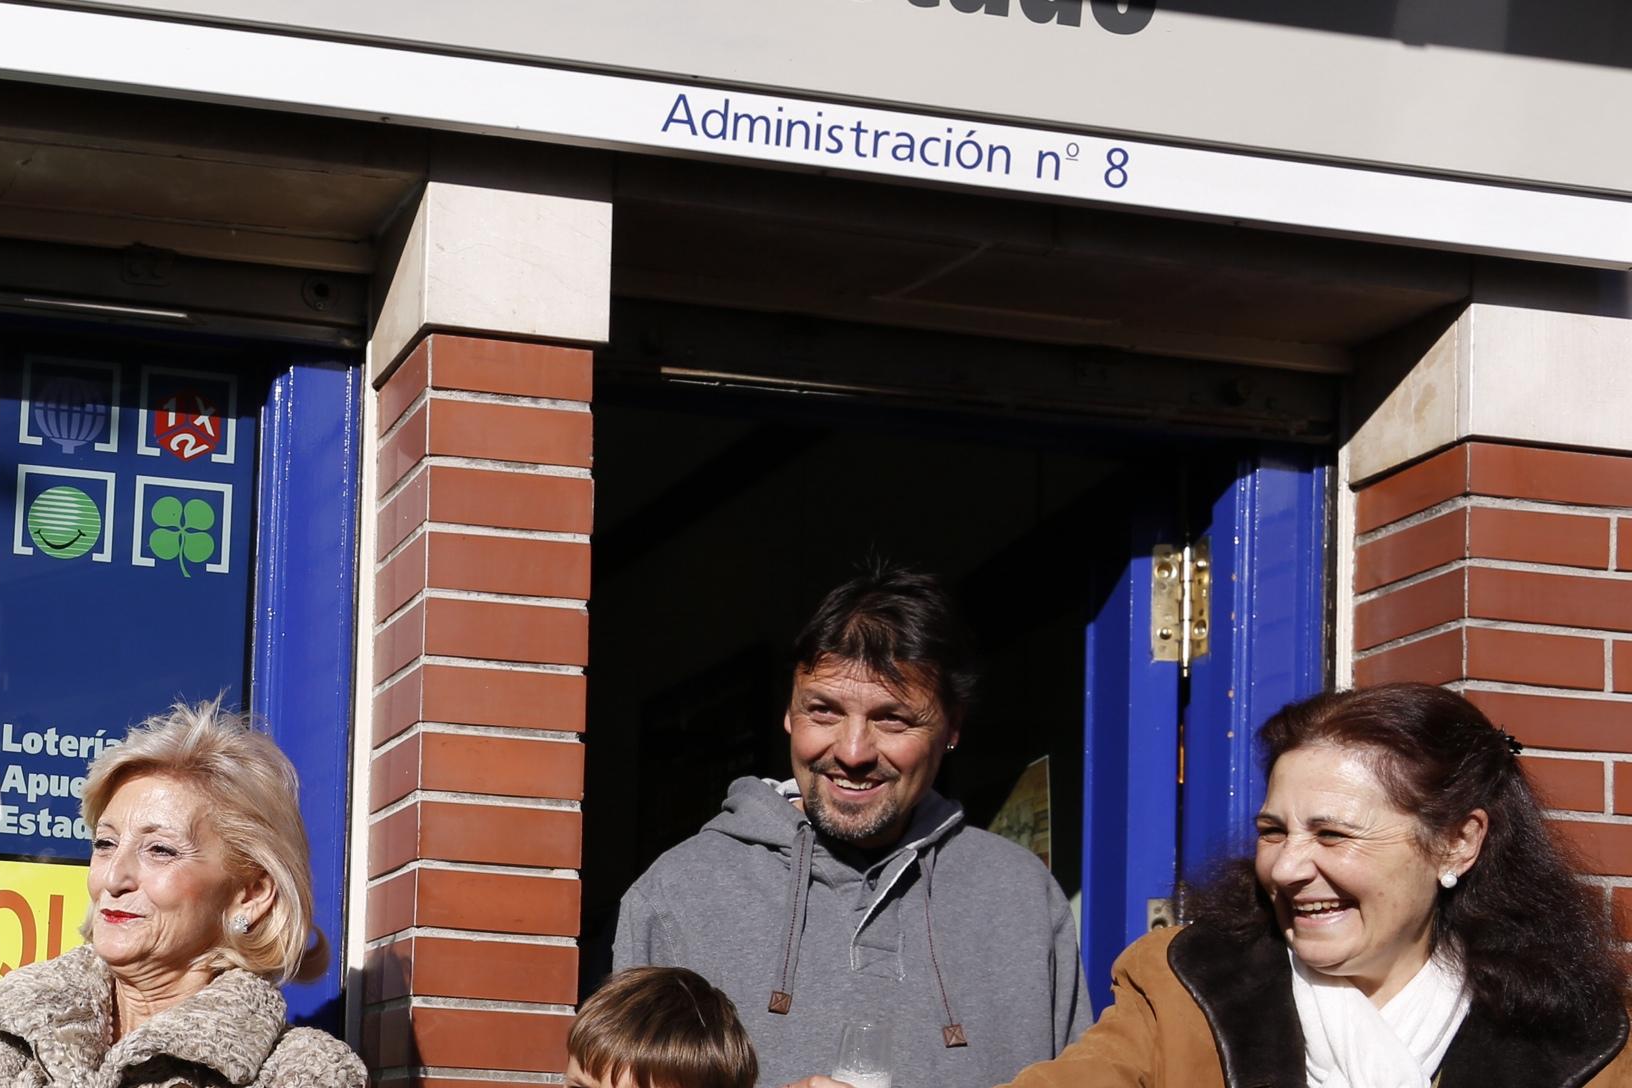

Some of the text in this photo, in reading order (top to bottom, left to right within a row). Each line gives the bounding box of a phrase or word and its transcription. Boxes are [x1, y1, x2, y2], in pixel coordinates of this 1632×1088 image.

[661, 93, 1012, 175] Administración
[1103, 147, 1130, 188] 8
[0, 765, 86, 803] Apue
